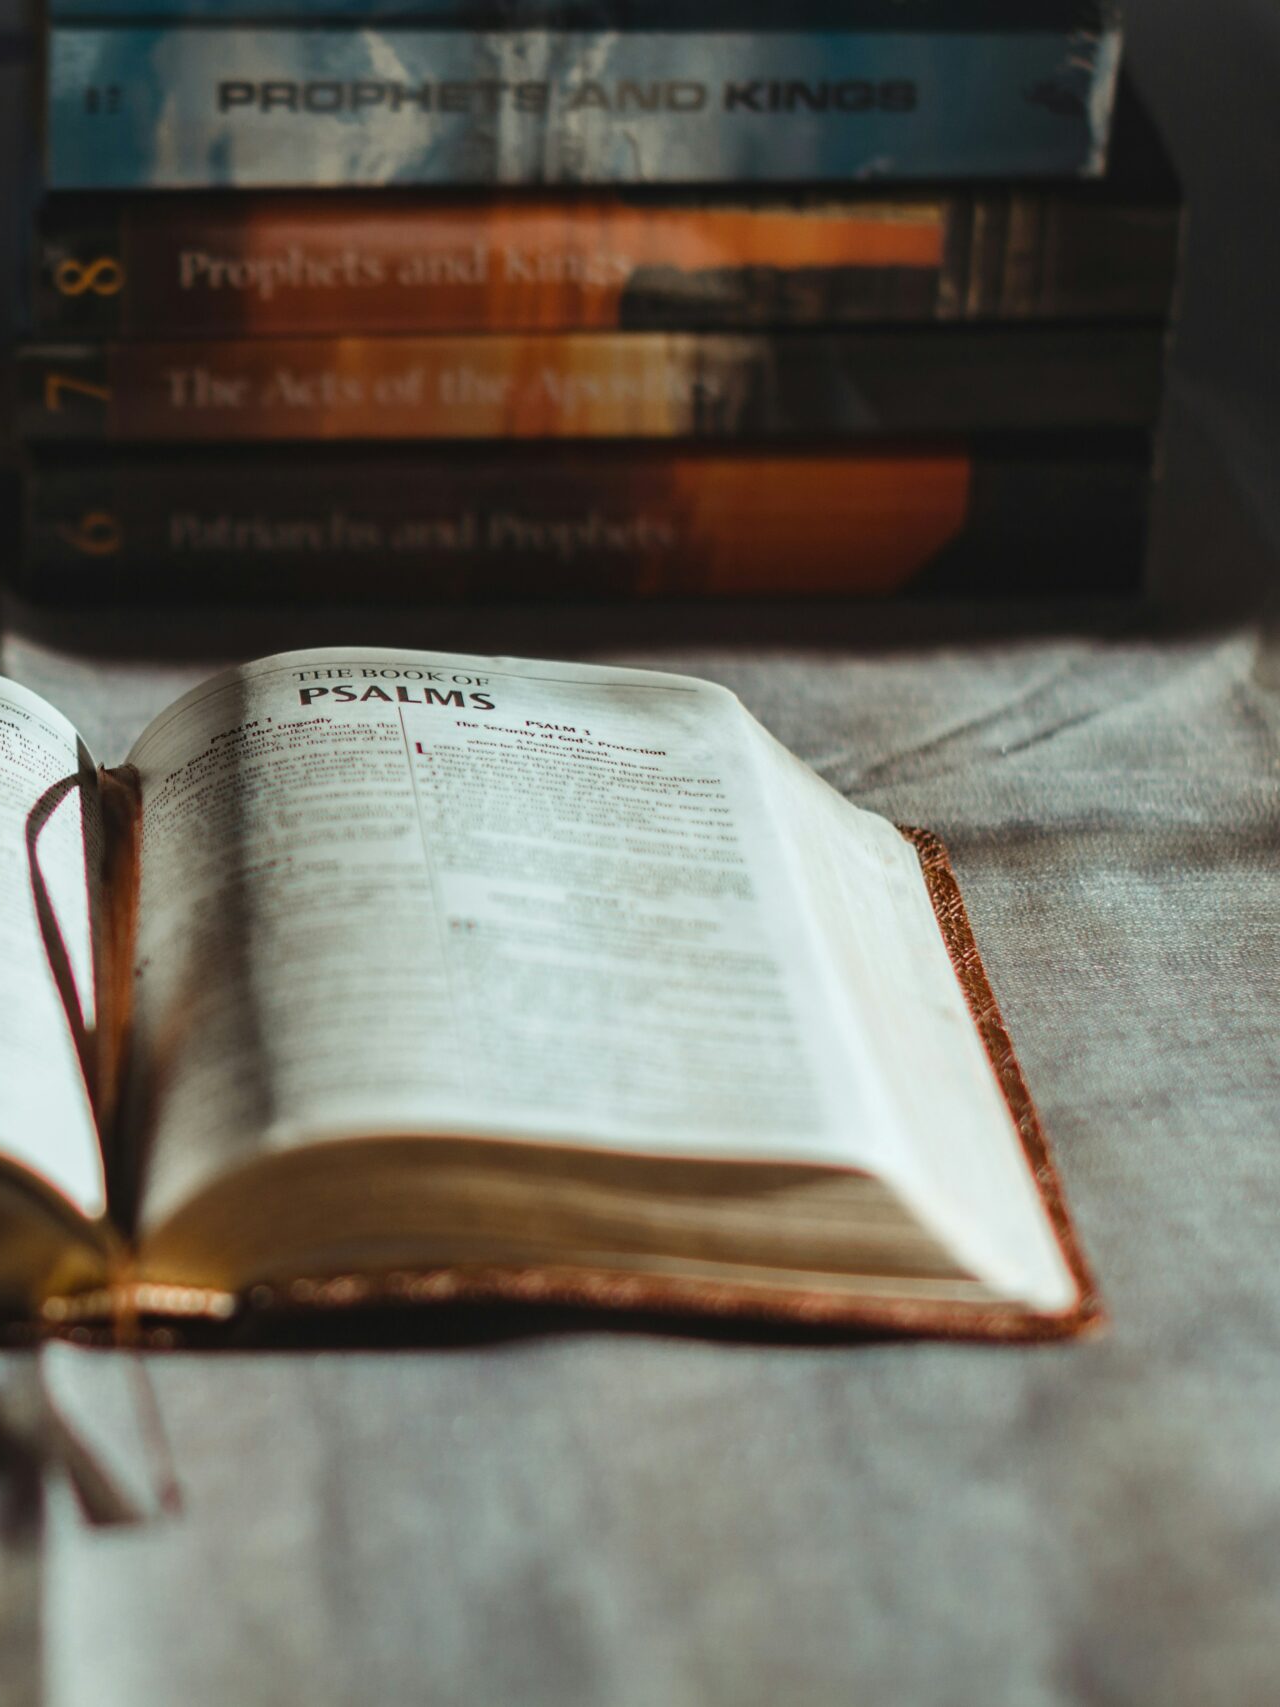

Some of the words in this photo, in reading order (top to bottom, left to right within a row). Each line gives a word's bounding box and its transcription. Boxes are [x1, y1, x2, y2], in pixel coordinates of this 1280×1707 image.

[217, 80, 549, 113] PROPHETS
[568, 80, 708, 112] AND
[724, 79, 919, 114] KINGS
[179, 247, 384, 299] Prophets
[397, 244, 488, 287] and
[504, 245, 631, 295] Kings
[45, 371, 111, 412] 7
[166, 367, 247, 409] The
[268, 367, 363, 409] Acts
[374, 367, 428, 409] of
[439, 366, 515, 409] the
[391, 510, 475, 552] and
[489, 509, 675, 560] Prophets
[292, 667, 353, 682] THE
[360, 667, 445, 682] BOOK
[451, 674, 490, 687] OF
[298, 684, 496, 711] PSALMS
[186, 746, 220, 767] Godly
[223, 734, 247, 748] and
[252, 728, 274, 737] the
[277, 717, 332, 730] Ungodly
[210, 721, 259, 744] PSALM
[456, 720, 479, 728] The
[483, 724, 535, 738] Security
[558, 734, 594, 745] God's
[598, 741, 668, 756] Protection
[525, 720, 577, 734] PSALM
[526, 740, 560, 749] Psalm
[467, 740, 497, 748] when
[570, 753, 618, 766] Absalom
